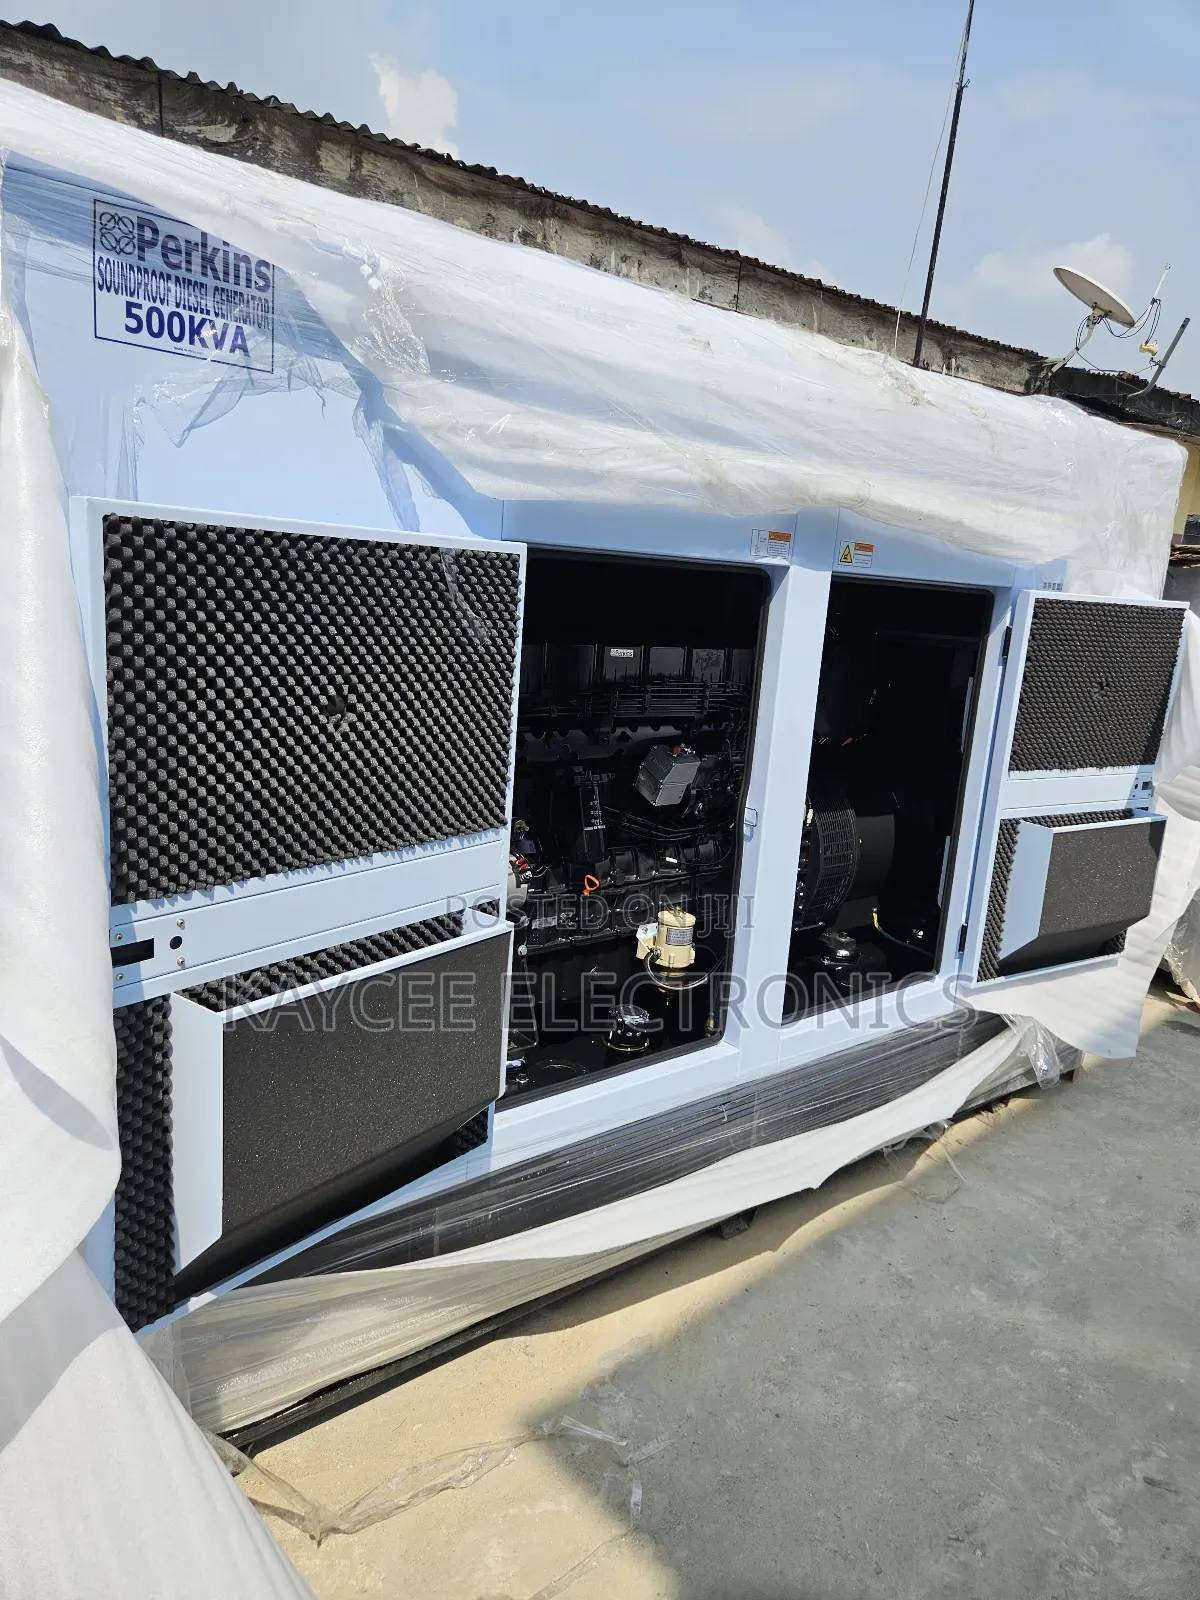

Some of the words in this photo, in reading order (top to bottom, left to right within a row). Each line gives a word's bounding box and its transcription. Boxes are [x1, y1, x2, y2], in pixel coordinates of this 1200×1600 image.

[136, 216, 272, 293] Perkins
[97, 256, 172, 307] SOUNDPROOF
[174, 275, 211, 316] DIESEL
[213, 285, 270, 330] GENERATOR
[124, 300, 251, 358] 500KVA
